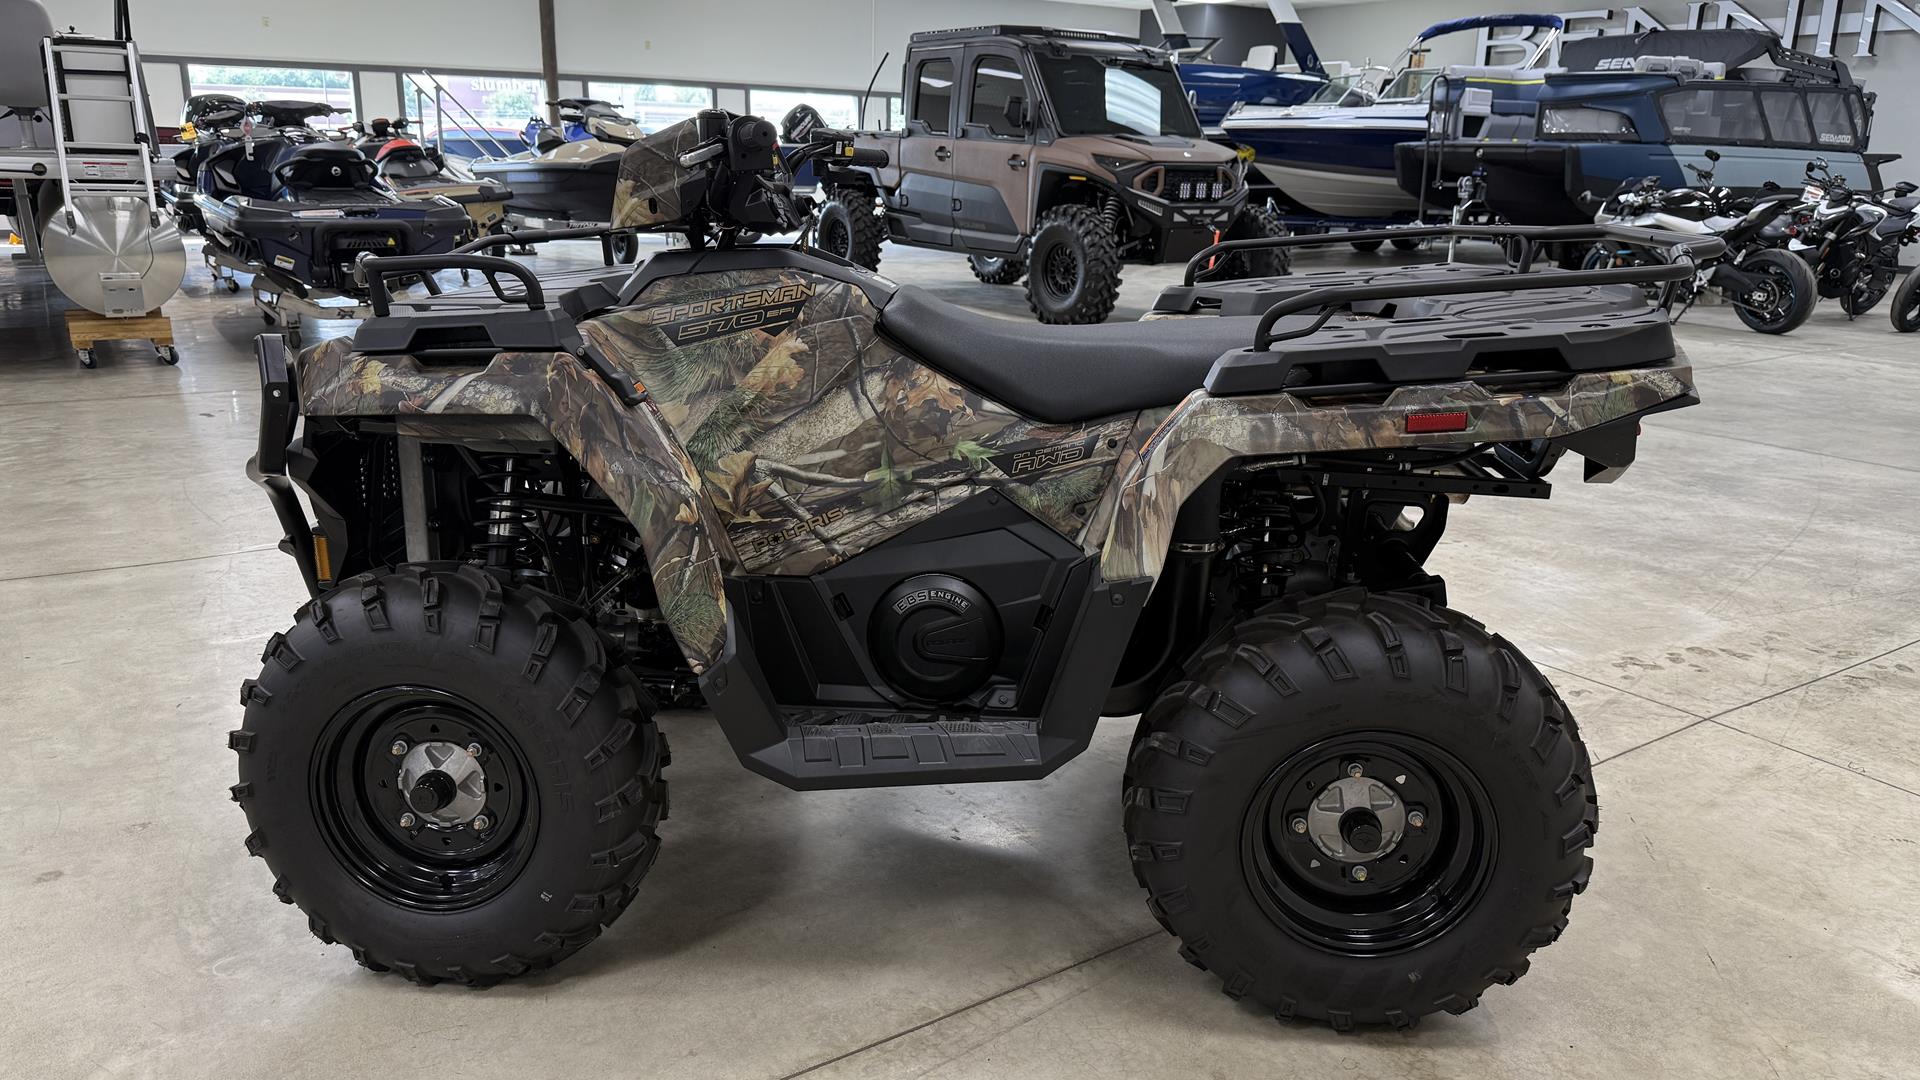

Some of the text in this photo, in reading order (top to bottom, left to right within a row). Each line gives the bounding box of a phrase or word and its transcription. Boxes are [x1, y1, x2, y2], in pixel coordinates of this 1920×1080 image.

[470, 77, 540, 92] slumber
[651, 283, 817, 325] SPORTSMAN
[677, 306, 795, 341] 570 EFI
[1011, 446, 1085, 474] AWD
[752, 507, 845, 554] POLARIS
[930, 590, 968, 610] ENGINE
